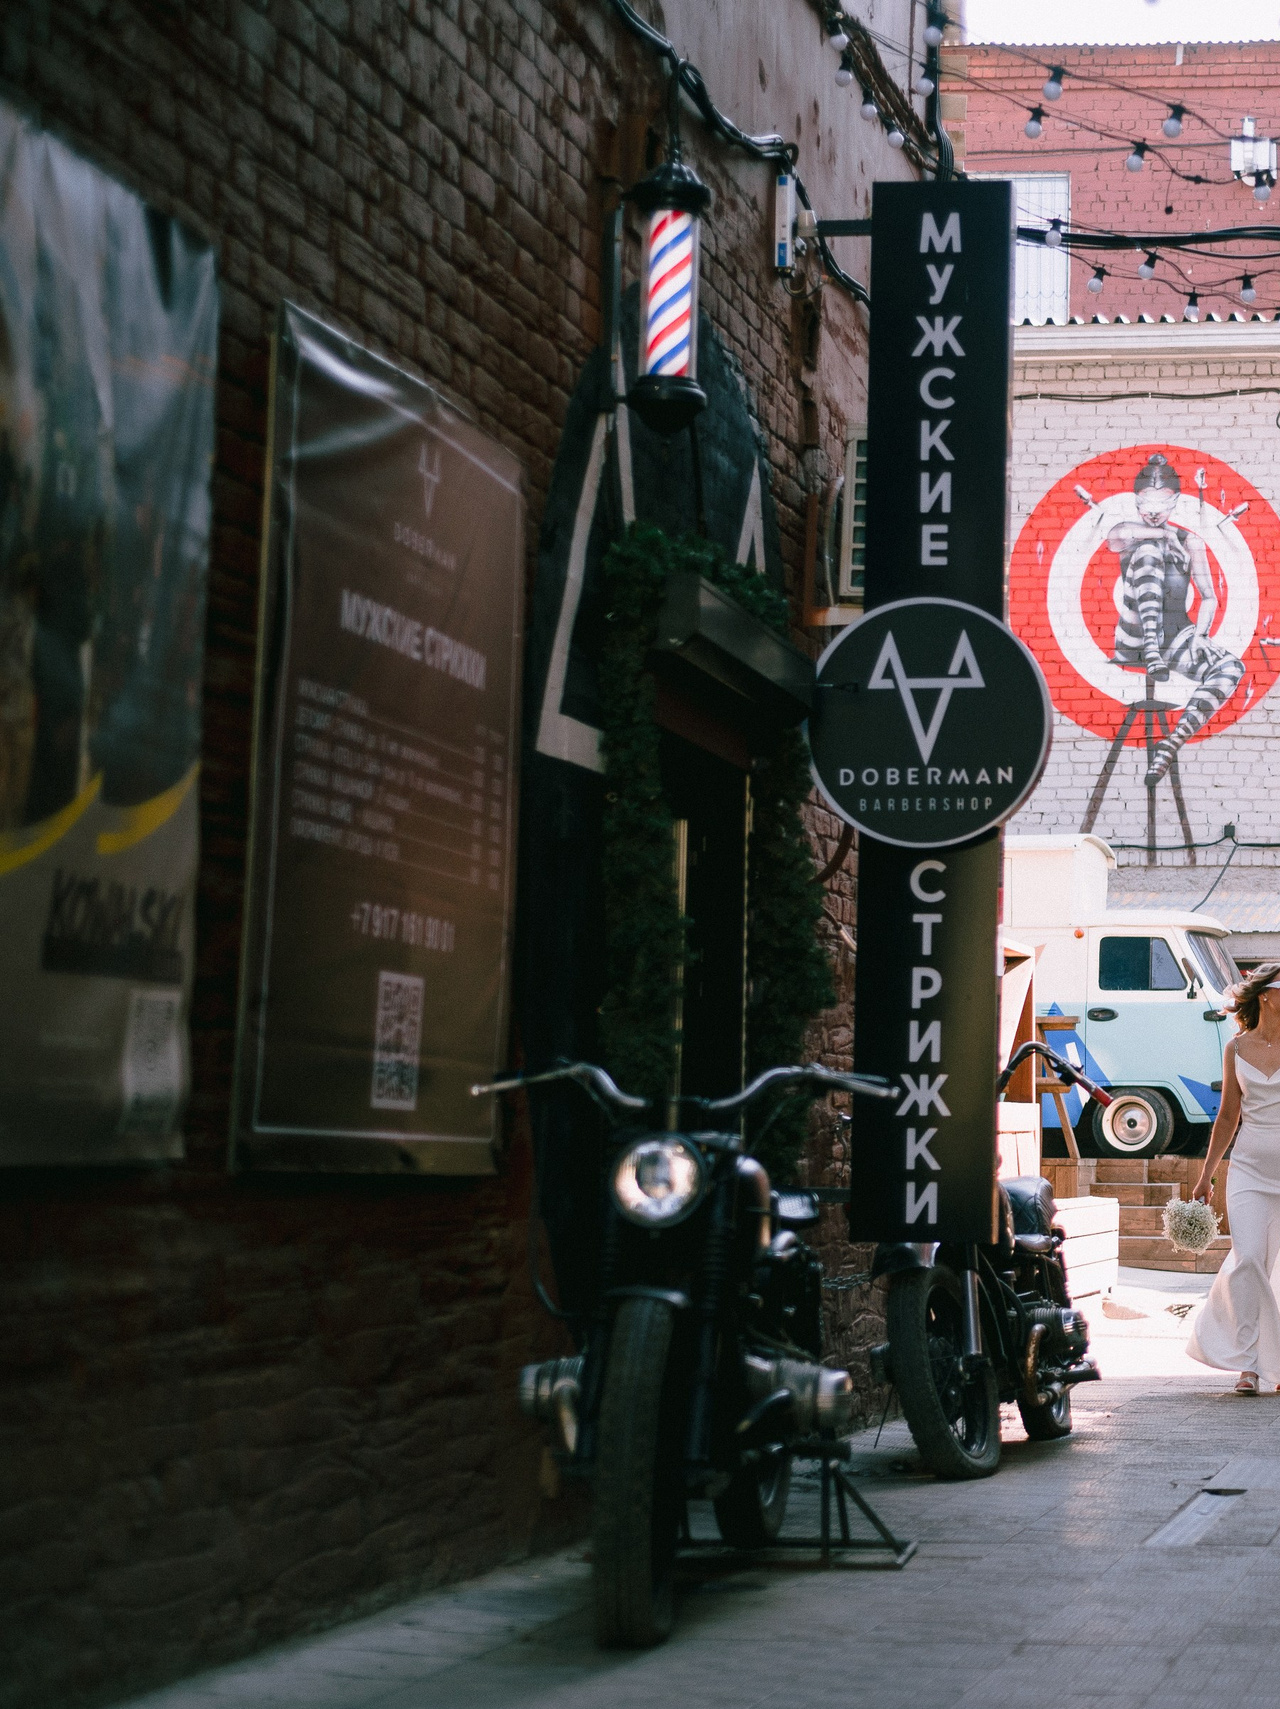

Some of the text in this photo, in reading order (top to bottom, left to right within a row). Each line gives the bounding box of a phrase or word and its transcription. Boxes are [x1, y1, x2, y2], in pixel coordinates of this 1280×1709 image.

[911, 211, 966, 566] МУЖСКИЕ
[839, 766, 1013, 786] DOBERMAN
[859, 796, 993, 812] BARBERSHOP
[895, 860, 951, 1225] СТРИЖКИ
